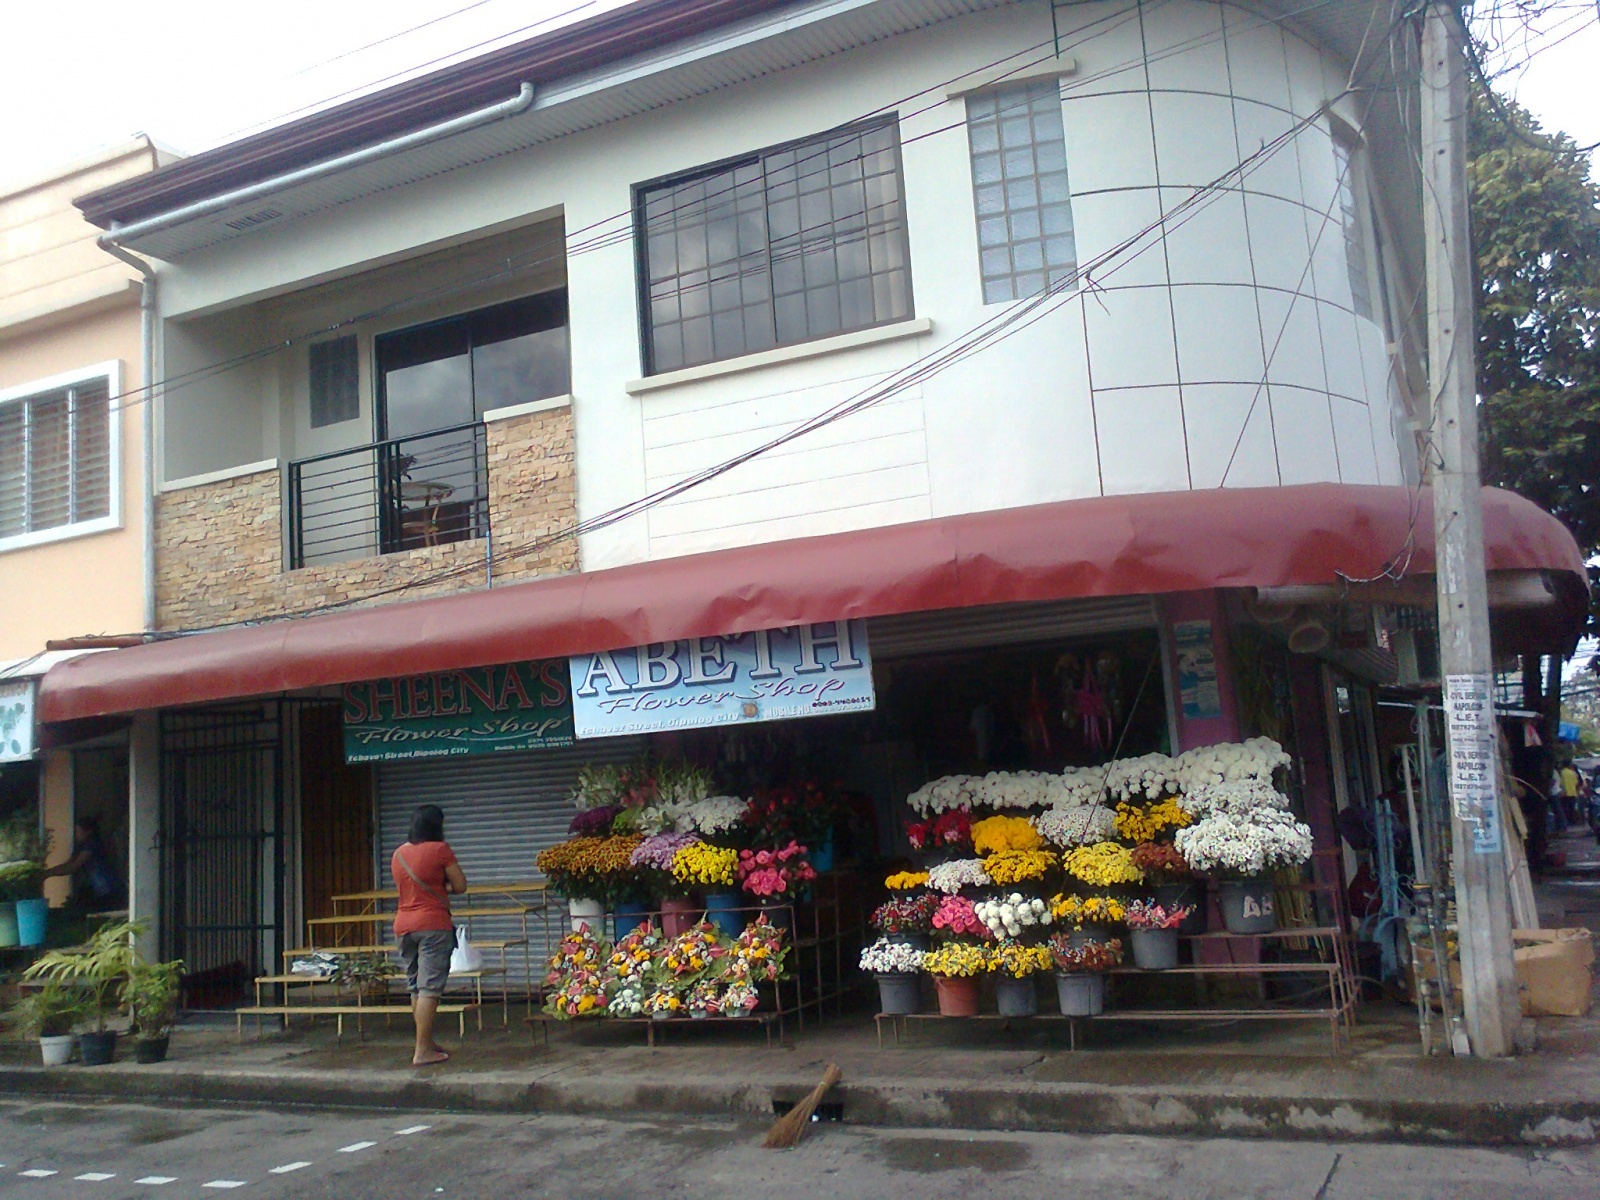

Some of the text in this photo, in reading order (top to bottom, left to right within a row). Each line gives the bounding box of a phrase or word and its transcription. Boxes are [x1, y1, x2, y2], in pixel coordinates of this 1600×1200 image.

[577, 619, 864, 698] ABETH
[344, 659, 567, 723] SHEENA'S
[597, 677, 846, 714] Flower Shop
[355, 716, 571, 744] Flower Shop
[716, 711, 740, 723] City
[450, 746, 470, 755] City
